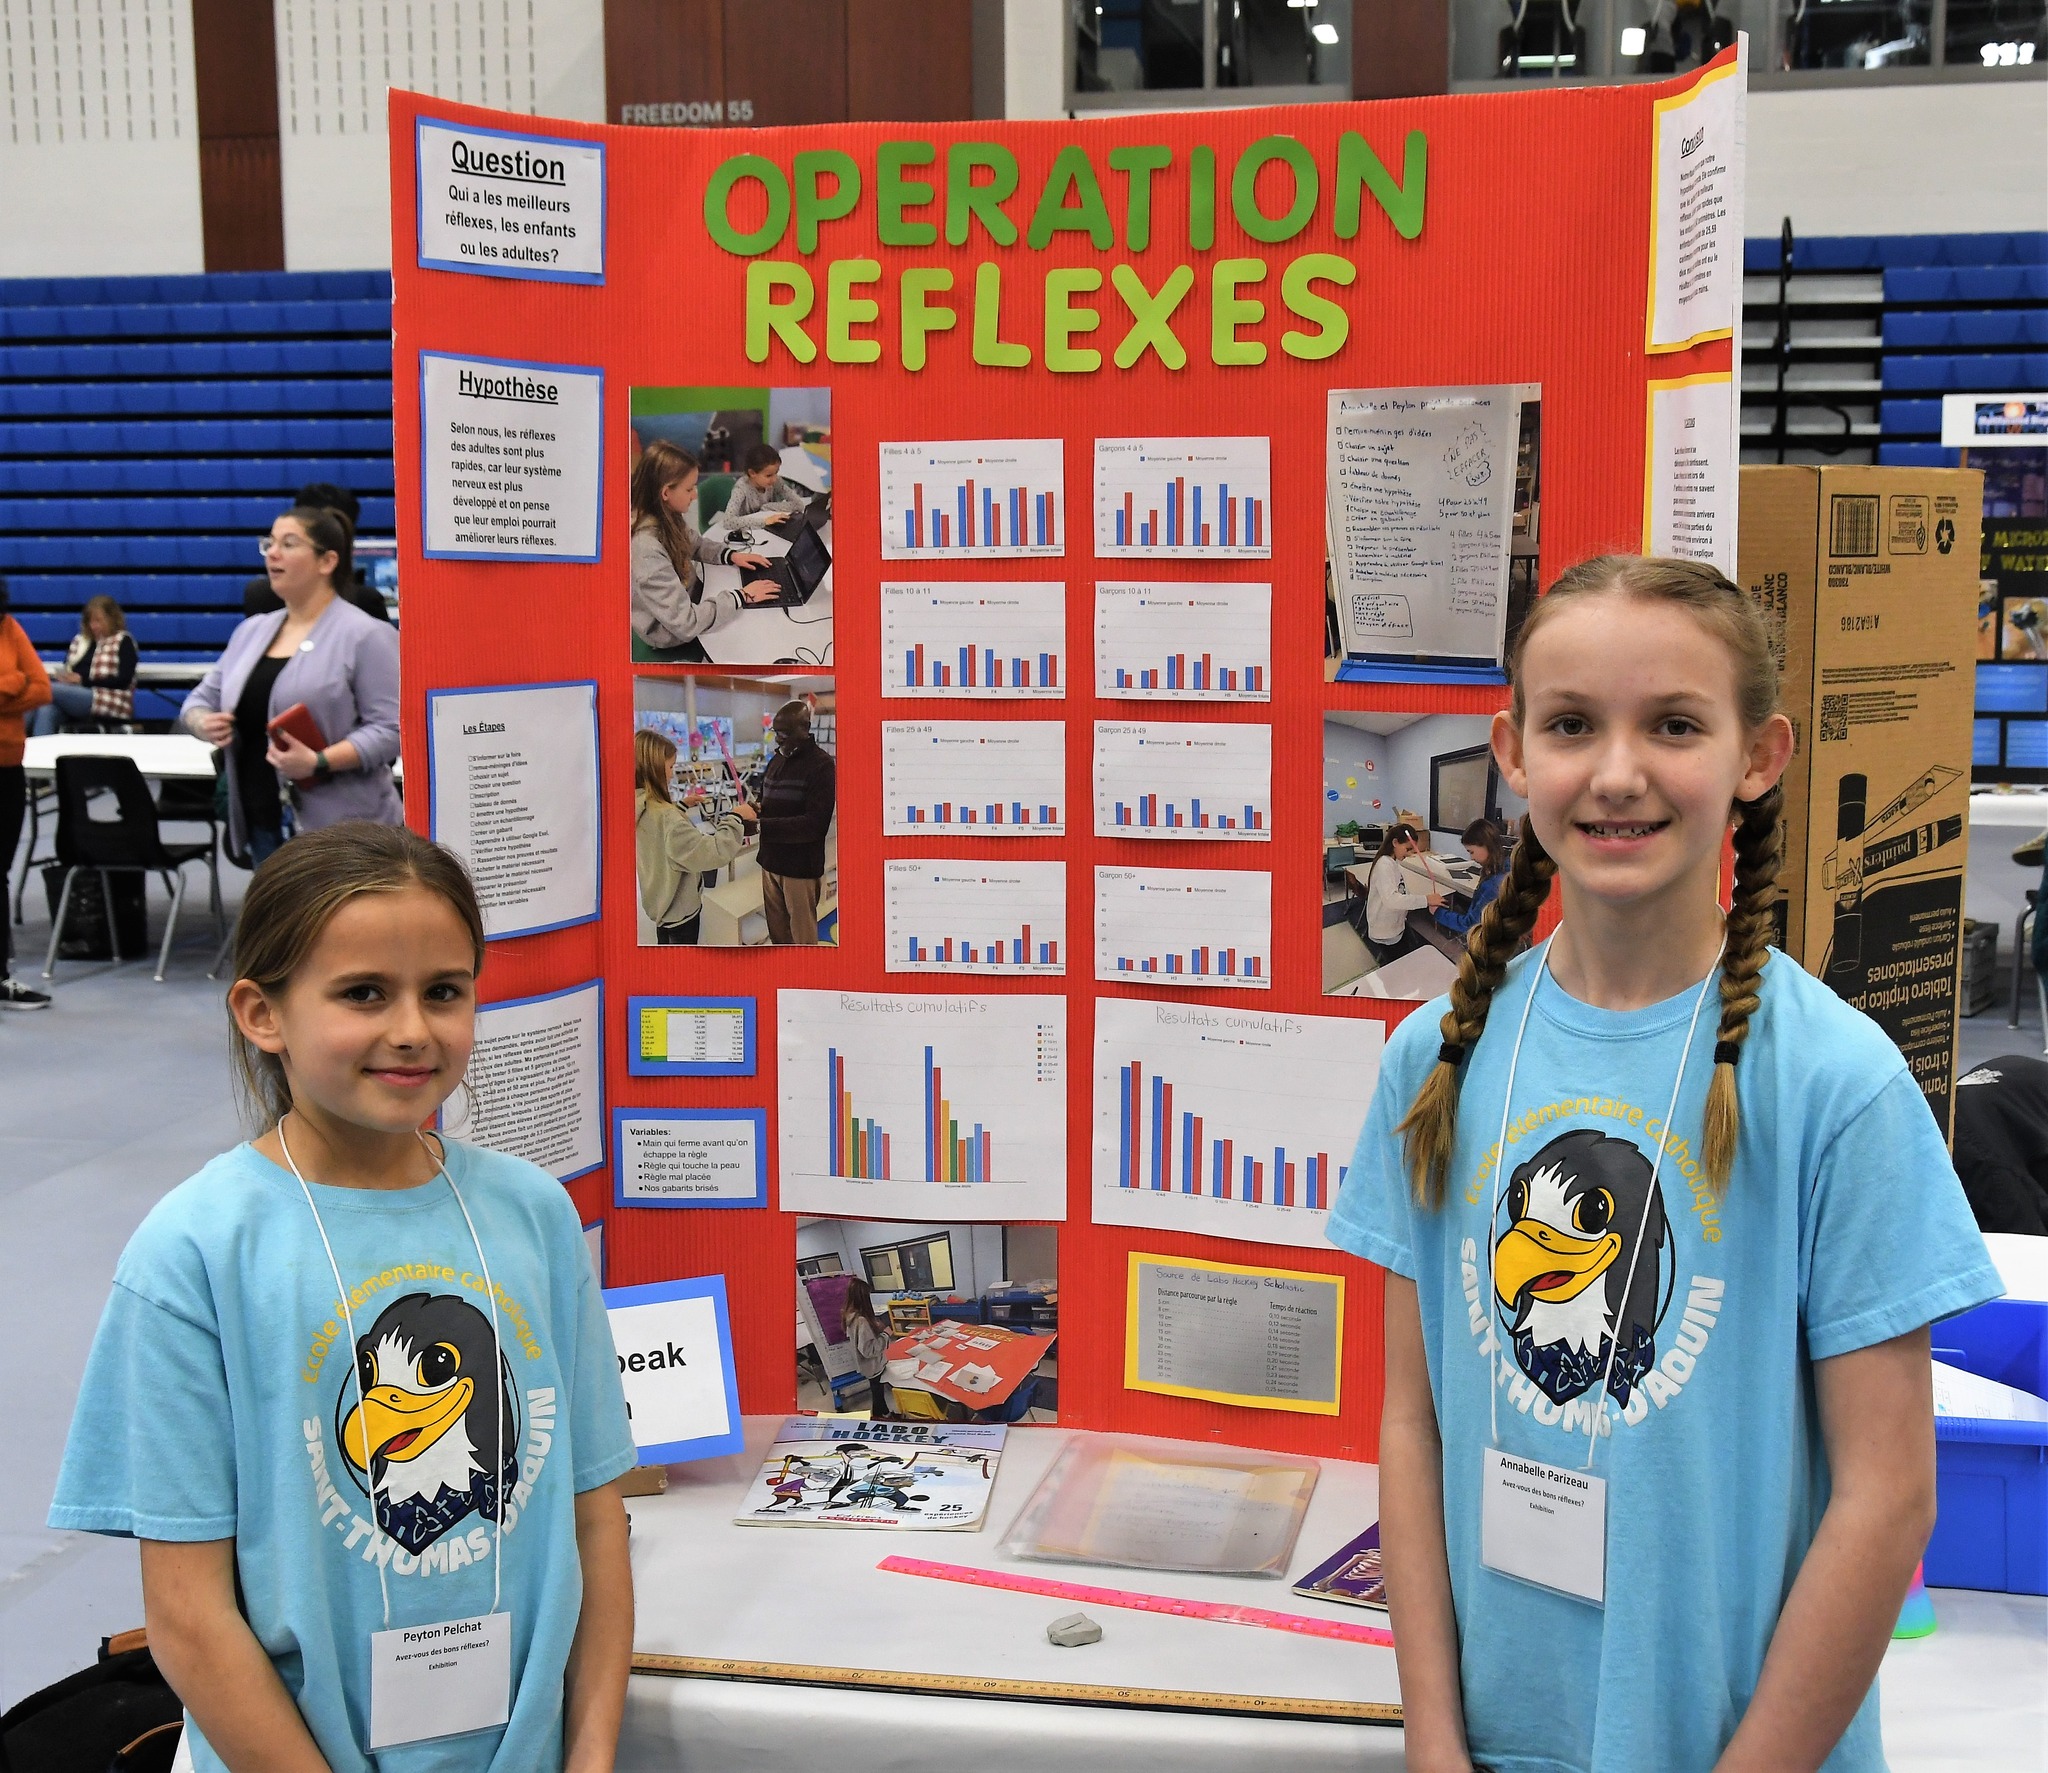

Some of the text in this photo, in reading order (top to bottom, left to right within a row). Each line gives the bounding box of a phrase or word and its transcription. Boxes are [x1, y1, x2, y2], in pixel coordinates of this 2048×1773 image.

[622, 101, 753, 125] FREEDOM 55
[452, 140, 566, 182] Question
[449, 185, 571, 213] Qui a les meilleurs
[704, 129, 1428, 256] OPERATION
[445, 211, 577, 238] réflexes, les enfants
[460, 242, 559, 263] ou les adultes?
[745, 253, 1357, 373] REFLEXES
[459, 370, 558, 401] Hypothèse
[451, 422, 556, 442] Selon nous, les réflexes
[451, 441, 545, 460] des adultes sont plus
[1099, 445, 1126, 453] Garçons
[451, 460, 562, 478] rapides, car leur système
[452, 478, 523, 493] nerveux est plus
[453, 495, 550, 512] développé et on pense
[454, 514, 556, 530] que leur emploi pourrait
[455, 532, 557, 546] améliorer leurs réflexes.
[1099, 588, 1126, 596] Garçons
[1128, 588, 1136, 596] 10
[463, 724, 477, 735] Les
[1098, 726, 1121, 735] Garçon
[1864, 835, 1912, 869] painters
[1099, 872, 1122, 880] Garçon
[1867, 948, 1954, 984] presentaciones
[1868, 975, 1952, 1009] Tablero tríptico
[840, 994, 987, 1014] Résultats cumulatifs
[1156, 1006, 1303, 1034] Résultats cumulatifs
[1915, 1054, 1941, 1075] trois
[1506, 1095, 1643, 1144] élémentaire
[629, 1128, 671, 1136] Variables:
[642, 1139, 662, 1147] Main
[664, 1140, 676, 1148] qui
[678, 1139, 701, 1147] ferme
[702, 1139, 725, 1147] avant
[643, 1150, 708, 1159] échappe la règle
[643, 1161, 740, 1171] Règle qui touche la peau
[643, 1173, 667, 1182] Règle
[685, 1173, 711, 1181] placée
[644, 1184, 660, 1192] Nos
[695, 1184, 719, 1192] brisés
[1158, 1287, 1179, 1298] Distance
[1179, 1290, 1207, 1302] parcourue
[1207, 1293, 1217, 1303] par
[460, 1270, 543, 1361] catholique
[1269, 1301, 1287, 1312] Temps
[831, 1431, 949, 1444] HOCKEY
[857, 1422, 929, 1435] LABO
[1500, 1457, 1589, 1490] Annabelle Parizeau
[1502, 1479, 1585, 1508] Avez-vous des bons réflexes?
[940, 1503, 963, 1512] 25
[1529, 1502, 1555, 1516] Exhibition
[403, 1621, 482, 1643] Peyton Pelchat
[395, 1640, 490, 1662] Avez-vous des bons réflexes?
[428, 1660, 458, 1671] Exhibition
